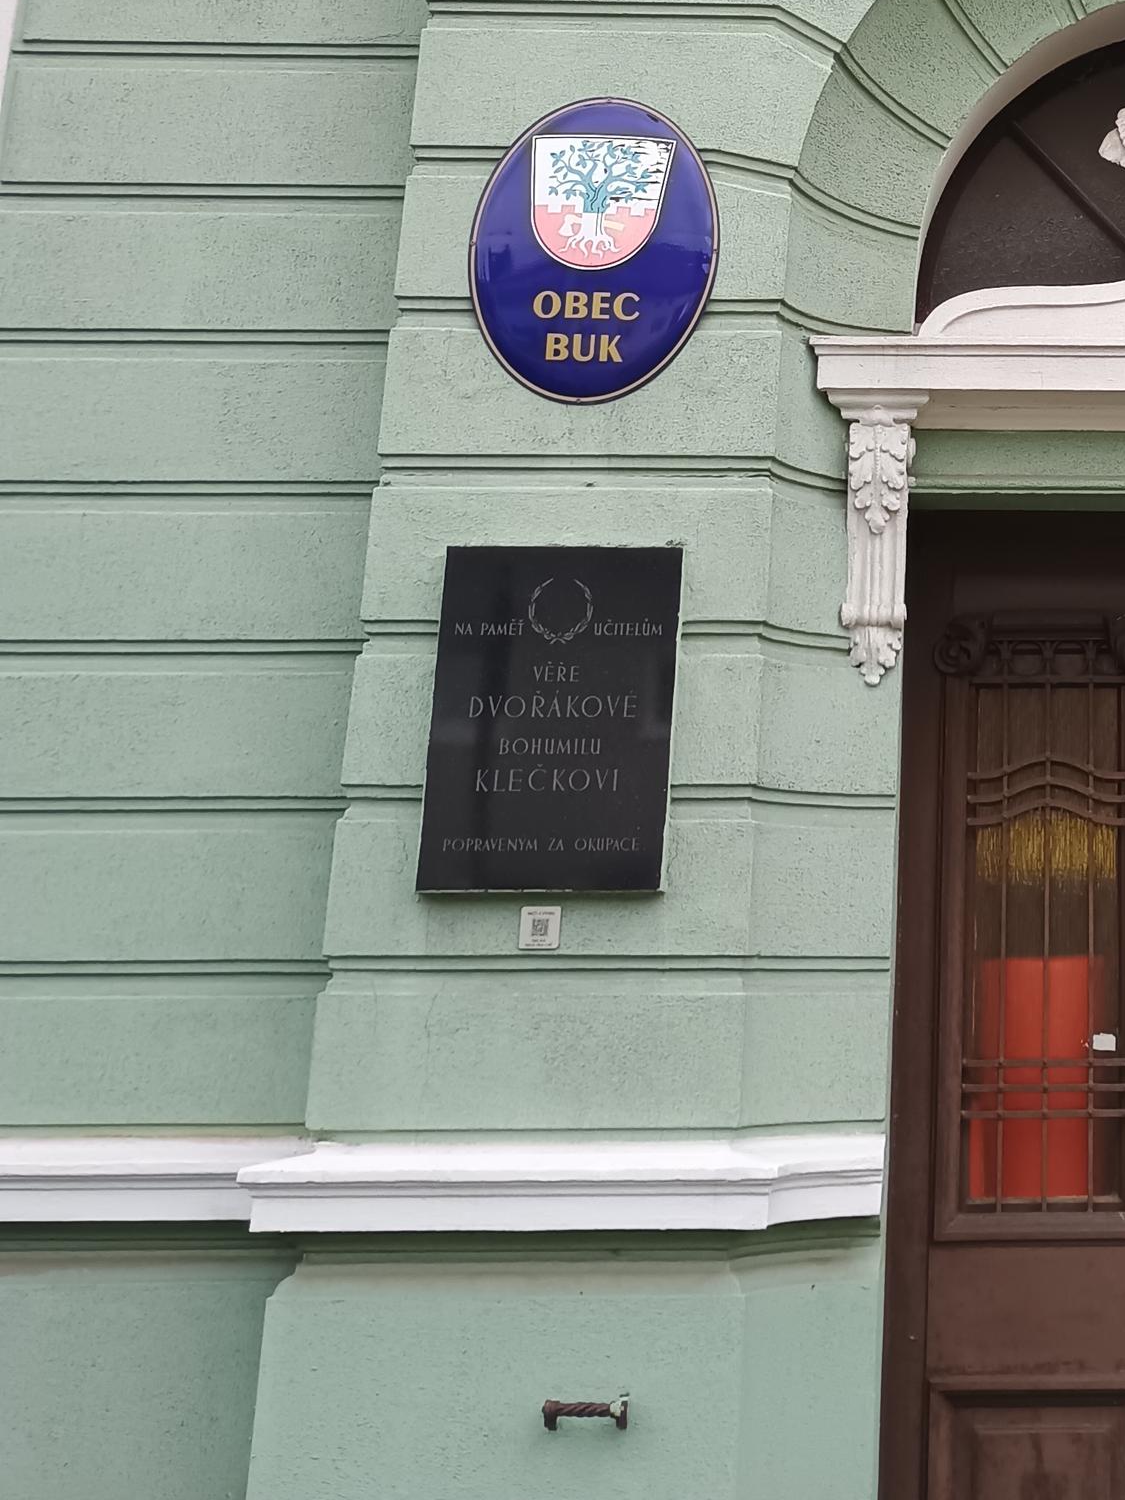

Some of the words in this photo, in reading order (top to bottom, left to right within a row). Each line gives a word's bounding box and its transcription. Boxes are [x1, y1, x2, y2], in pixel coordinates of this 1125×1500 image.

[532, 290, 640, 321] OBEC
[545, 332, 622, 362] BUK
[454, 622, 473, 636] NA
[594, 618, 663, 636] UČITELŮM
[533, 661, 580, 682] VĚŘE
[468, 689, 638, 718] DVOŘÁKOVÉ
[498, 737, 601, 756] BOHUMILU
[475, 764, 619, 792] KLEČKOVI
[549, 837, 564, 851] ZA
[574, 837, 640, 851] OKUPACE
